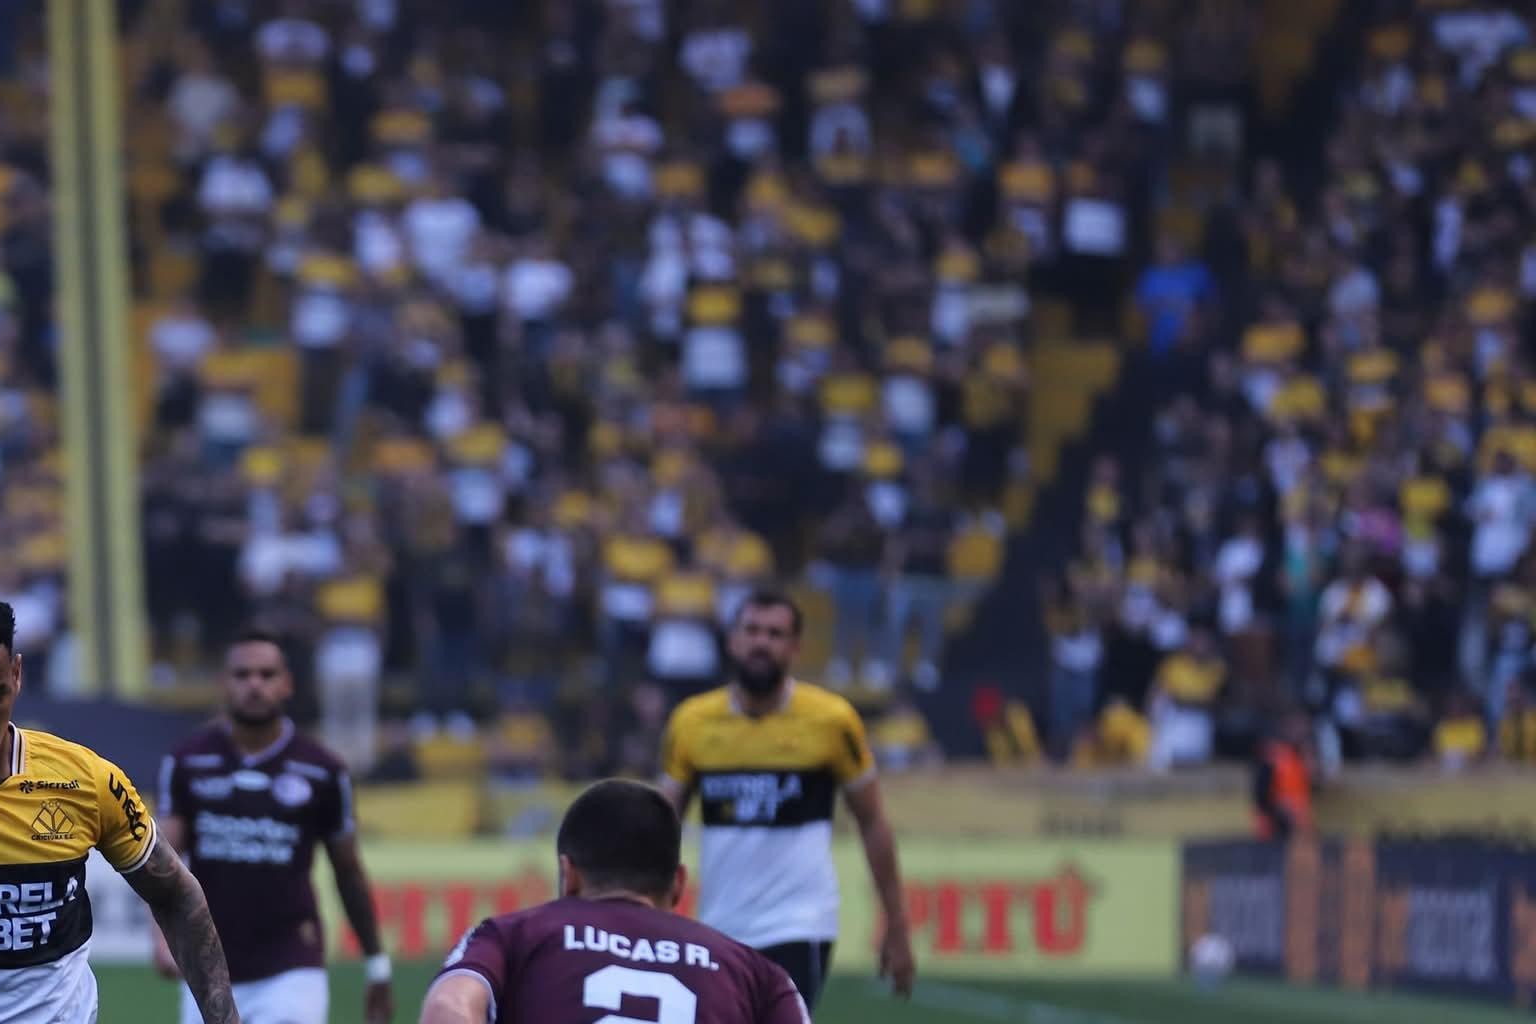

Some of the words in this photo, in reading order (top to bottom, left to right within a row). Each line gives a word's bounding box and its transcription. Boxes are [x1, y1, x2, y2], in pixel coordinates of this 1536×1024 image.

[36, 779, 80, 790] Sicredi
[563, 924, 680, 965] LUCAS
[684, 942, 720, 971] R.
